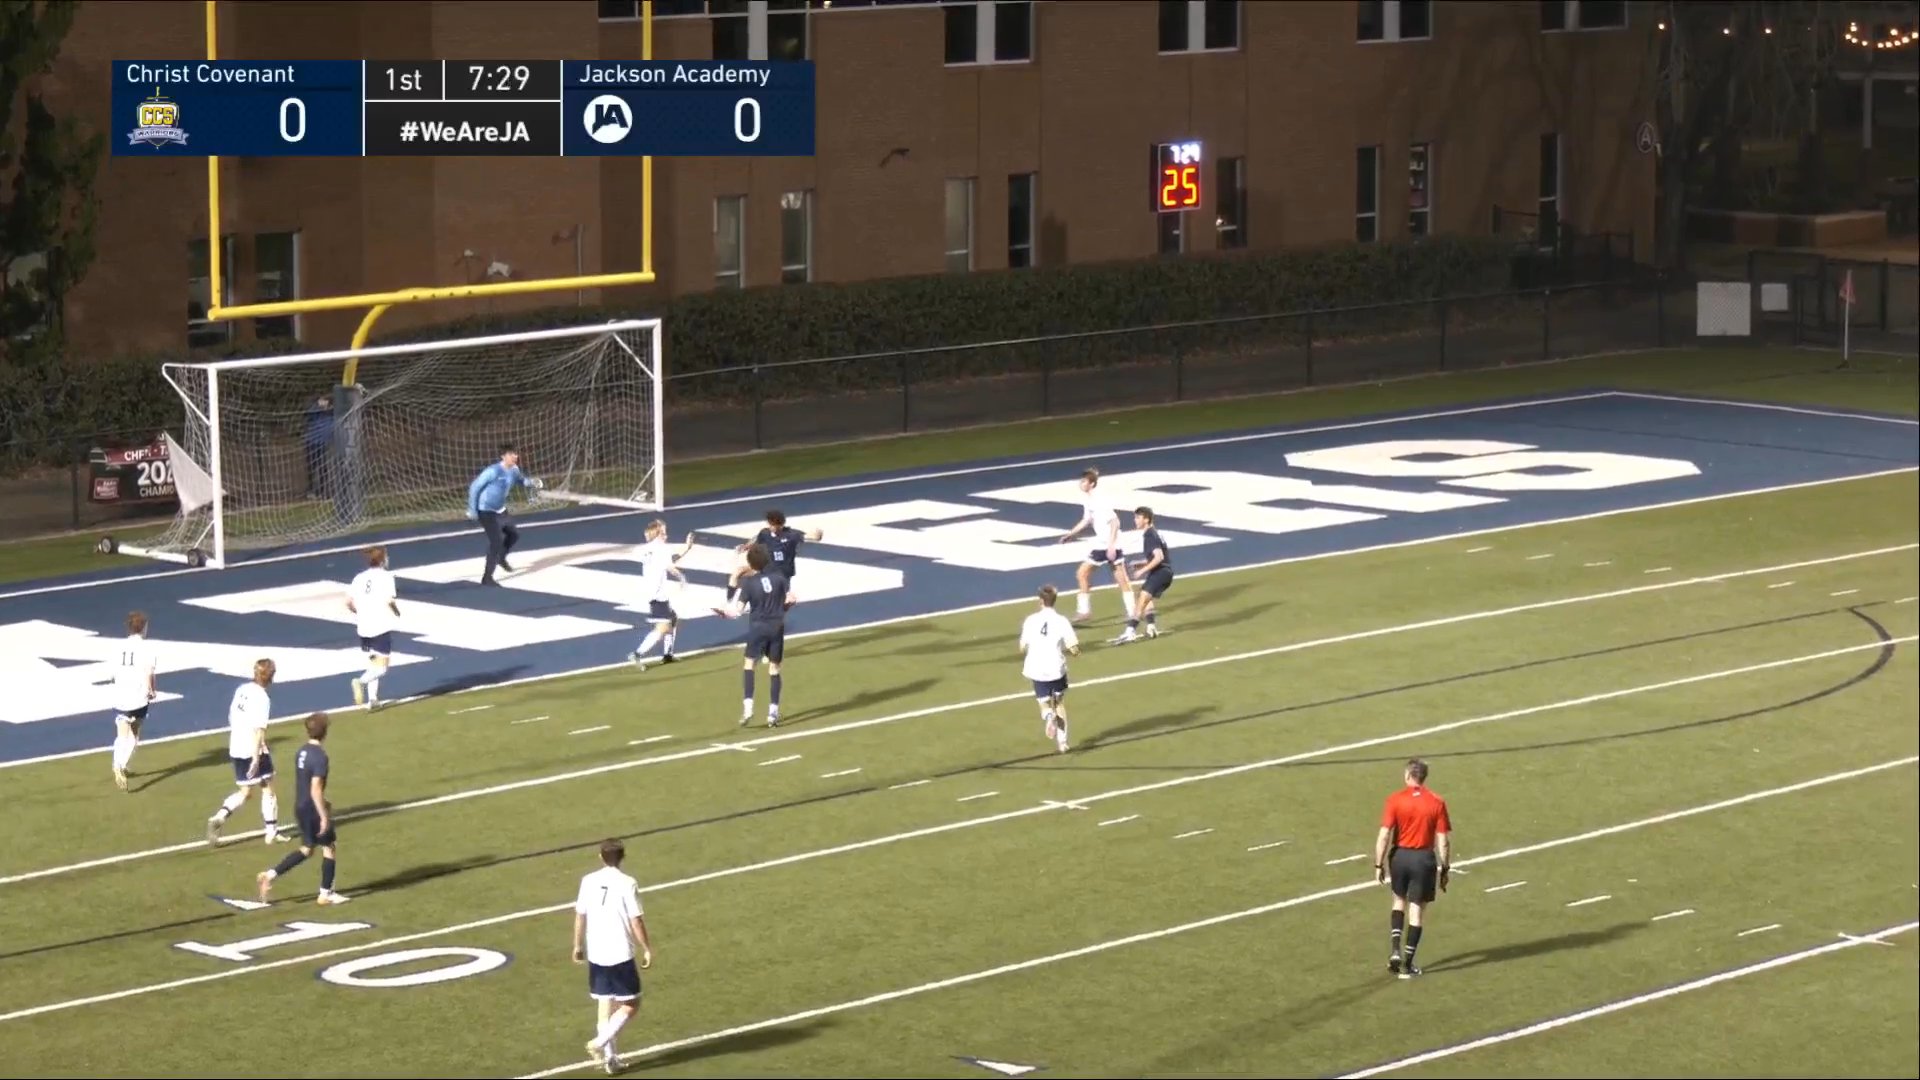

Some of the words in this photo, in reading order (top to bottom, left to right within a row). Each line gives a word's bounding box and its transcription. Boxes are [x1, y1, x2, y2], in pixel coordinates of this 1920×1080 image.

[1162, 167, 1198, 206] 25
[365, 579, 372, 594] 8
[1040, 621, 1048, 637] 4
[122, 651, 135, 666] 11
[601, 886, 608, 906] 7
